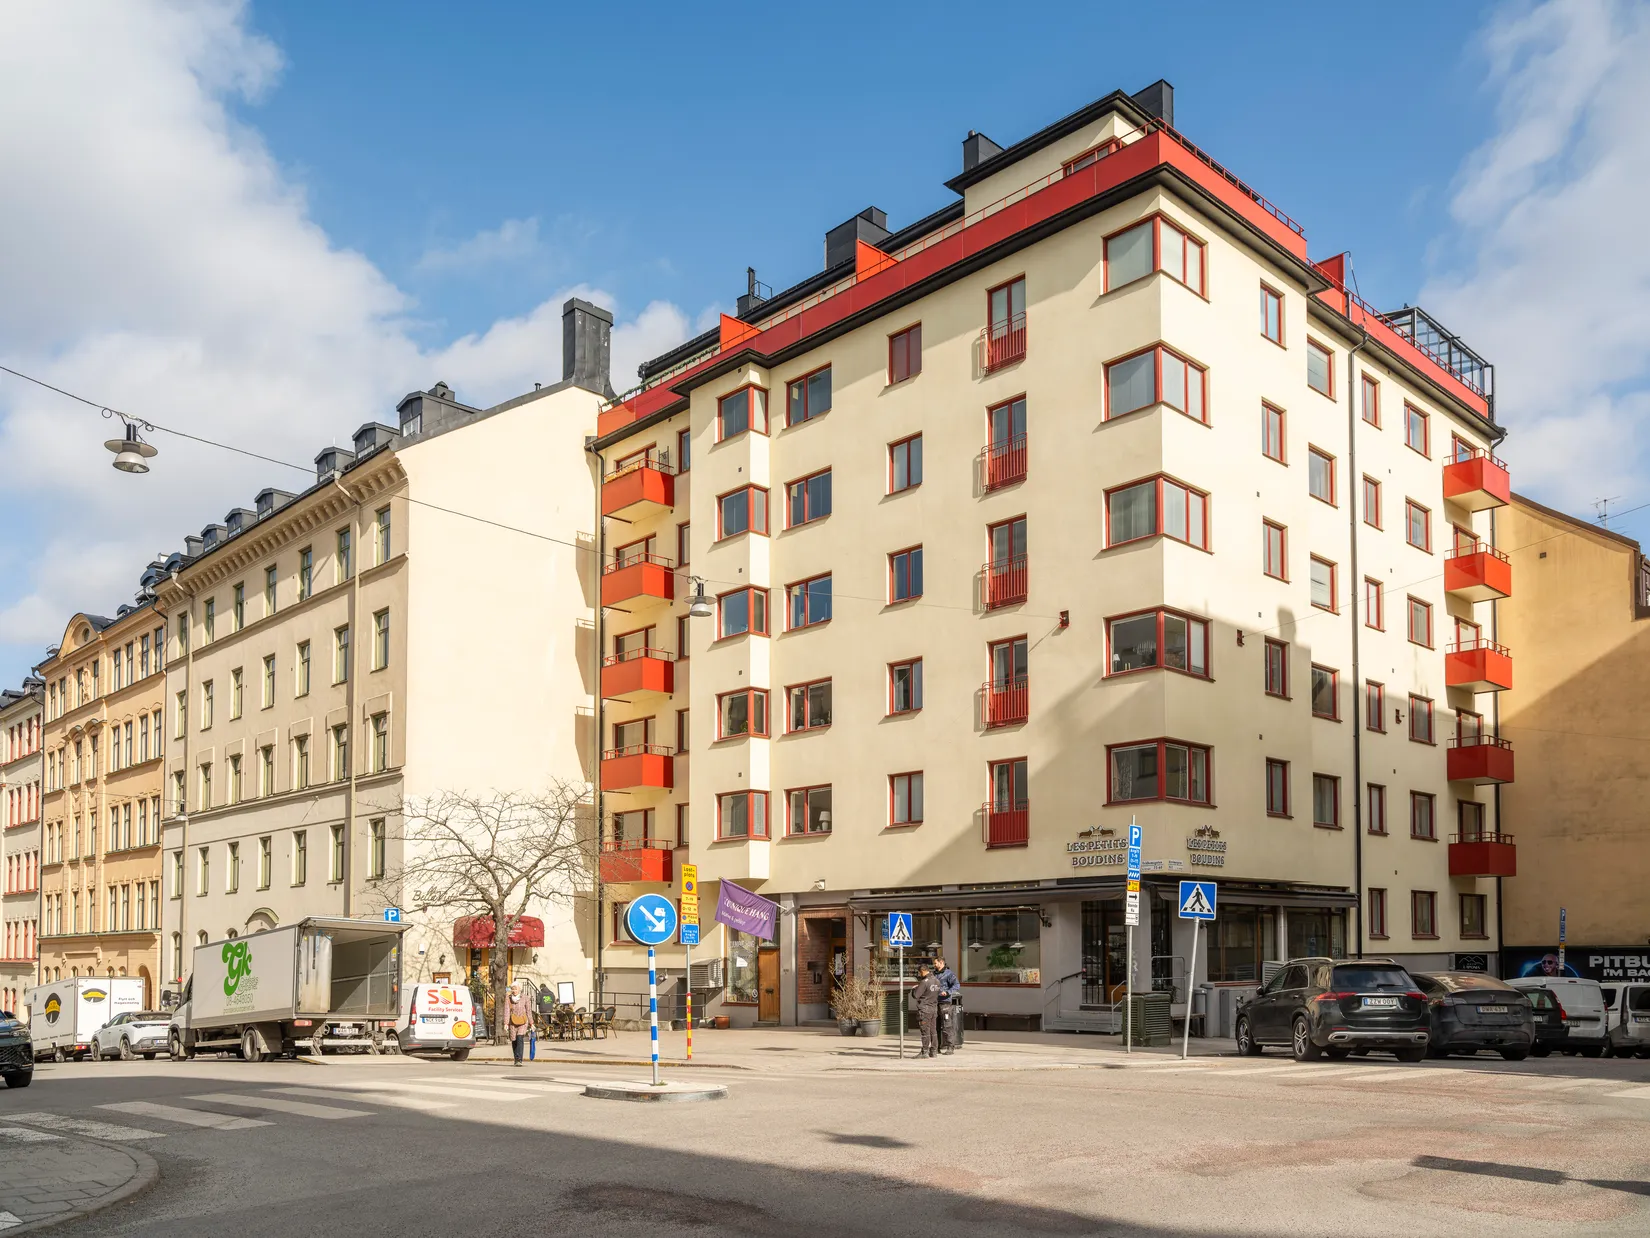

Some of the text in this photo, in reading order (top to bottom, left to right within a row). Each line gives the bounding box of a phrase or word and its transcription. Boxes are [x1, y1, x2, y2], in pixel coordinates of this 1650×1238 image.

[1131, 828, 1140, 845] P
[1066, 838, 1129, 852] LES PETITS
[1203, 839, 1227, 852] PETITS
[1072, 854, 1126, 867] BOUDINS
[1190, 853, 1225, 867] BOUDINS
[387, 910, 397, 921] P
[749, 909, 770, 921] HANG
[1603, 968, 1624, 977] I'M
